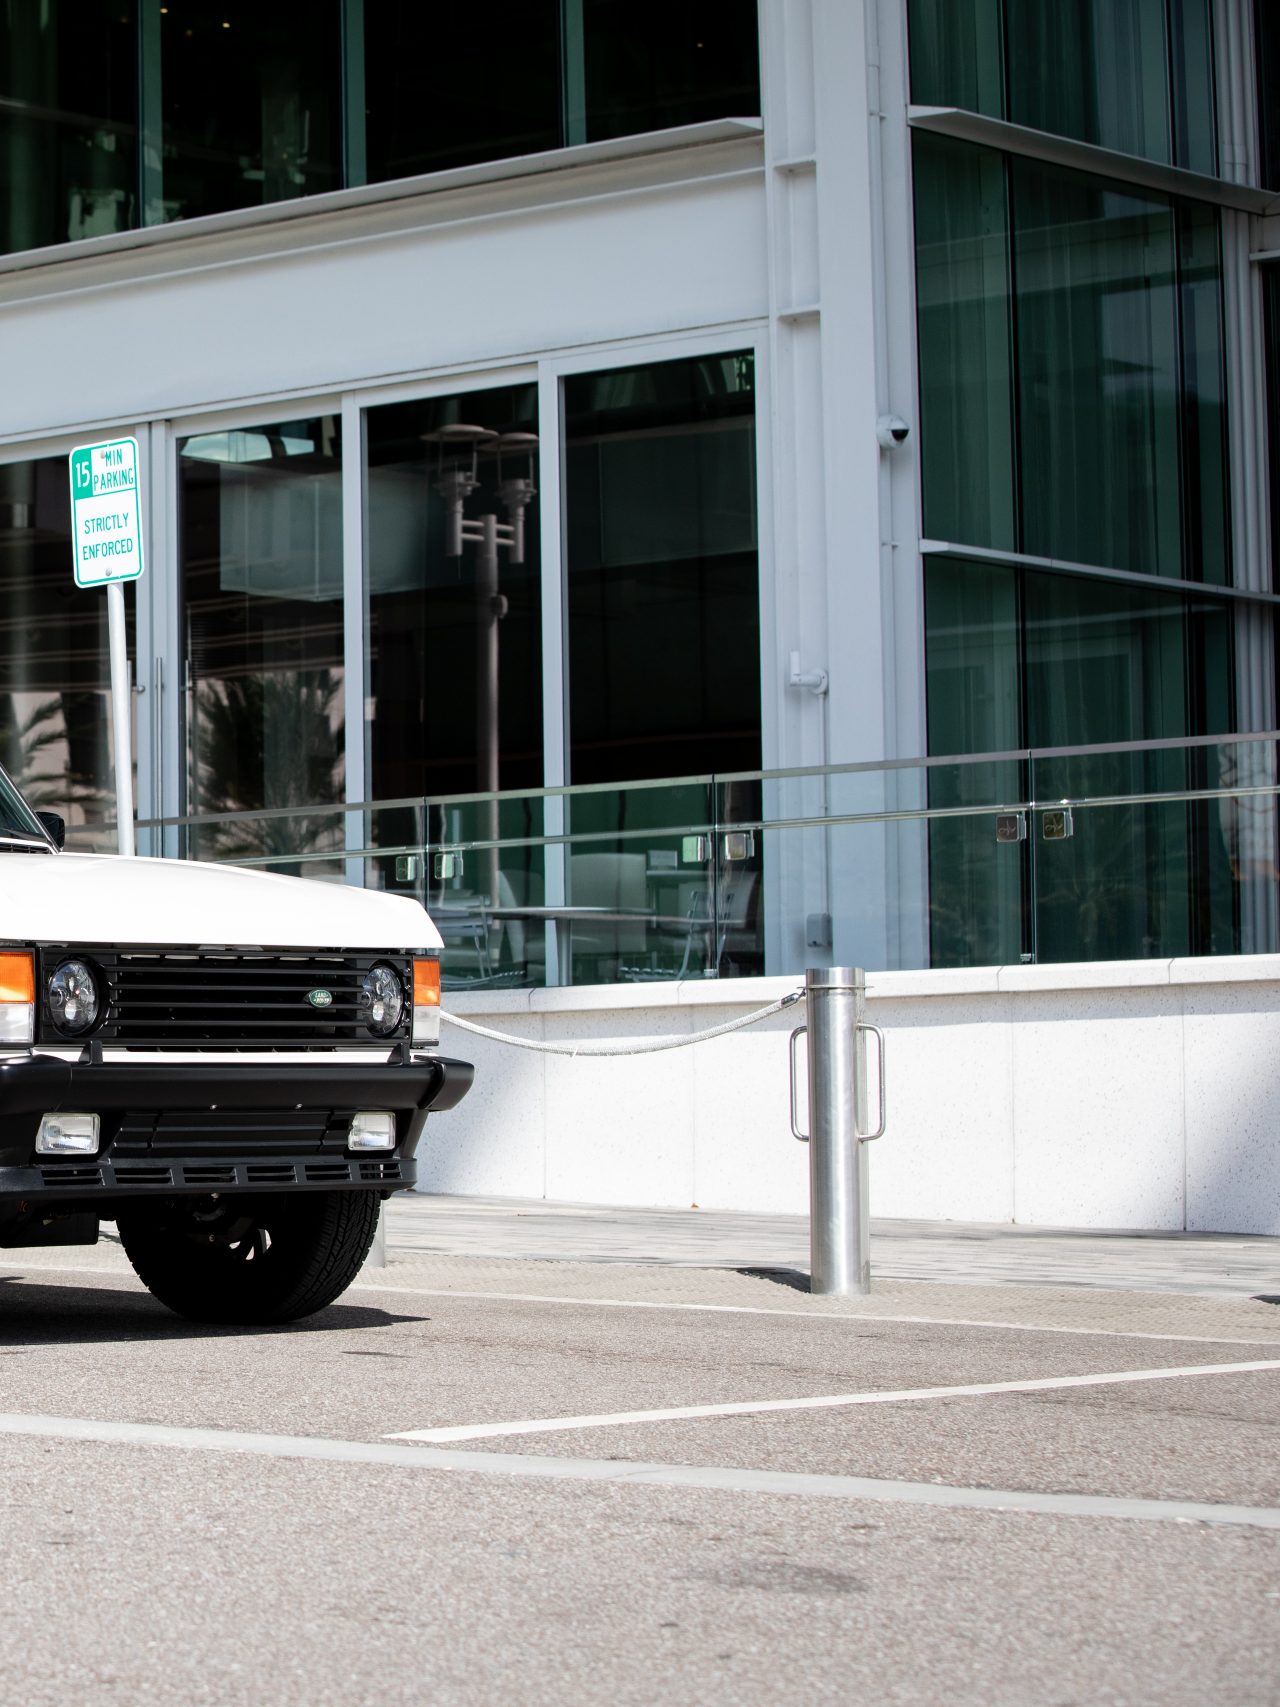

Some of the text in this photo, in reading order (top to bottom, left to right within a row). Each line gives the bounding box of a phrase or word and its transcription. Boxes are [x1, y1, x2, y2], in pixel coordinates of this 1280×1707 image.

[105, 448, 123, 467] MIN
[75, 461, 91, 488] 15
[93, 468, 134, 491] PARKING
[84, 512, 129, 534] STRICTLY
[82, 538, 133, 561] ENFORCED
